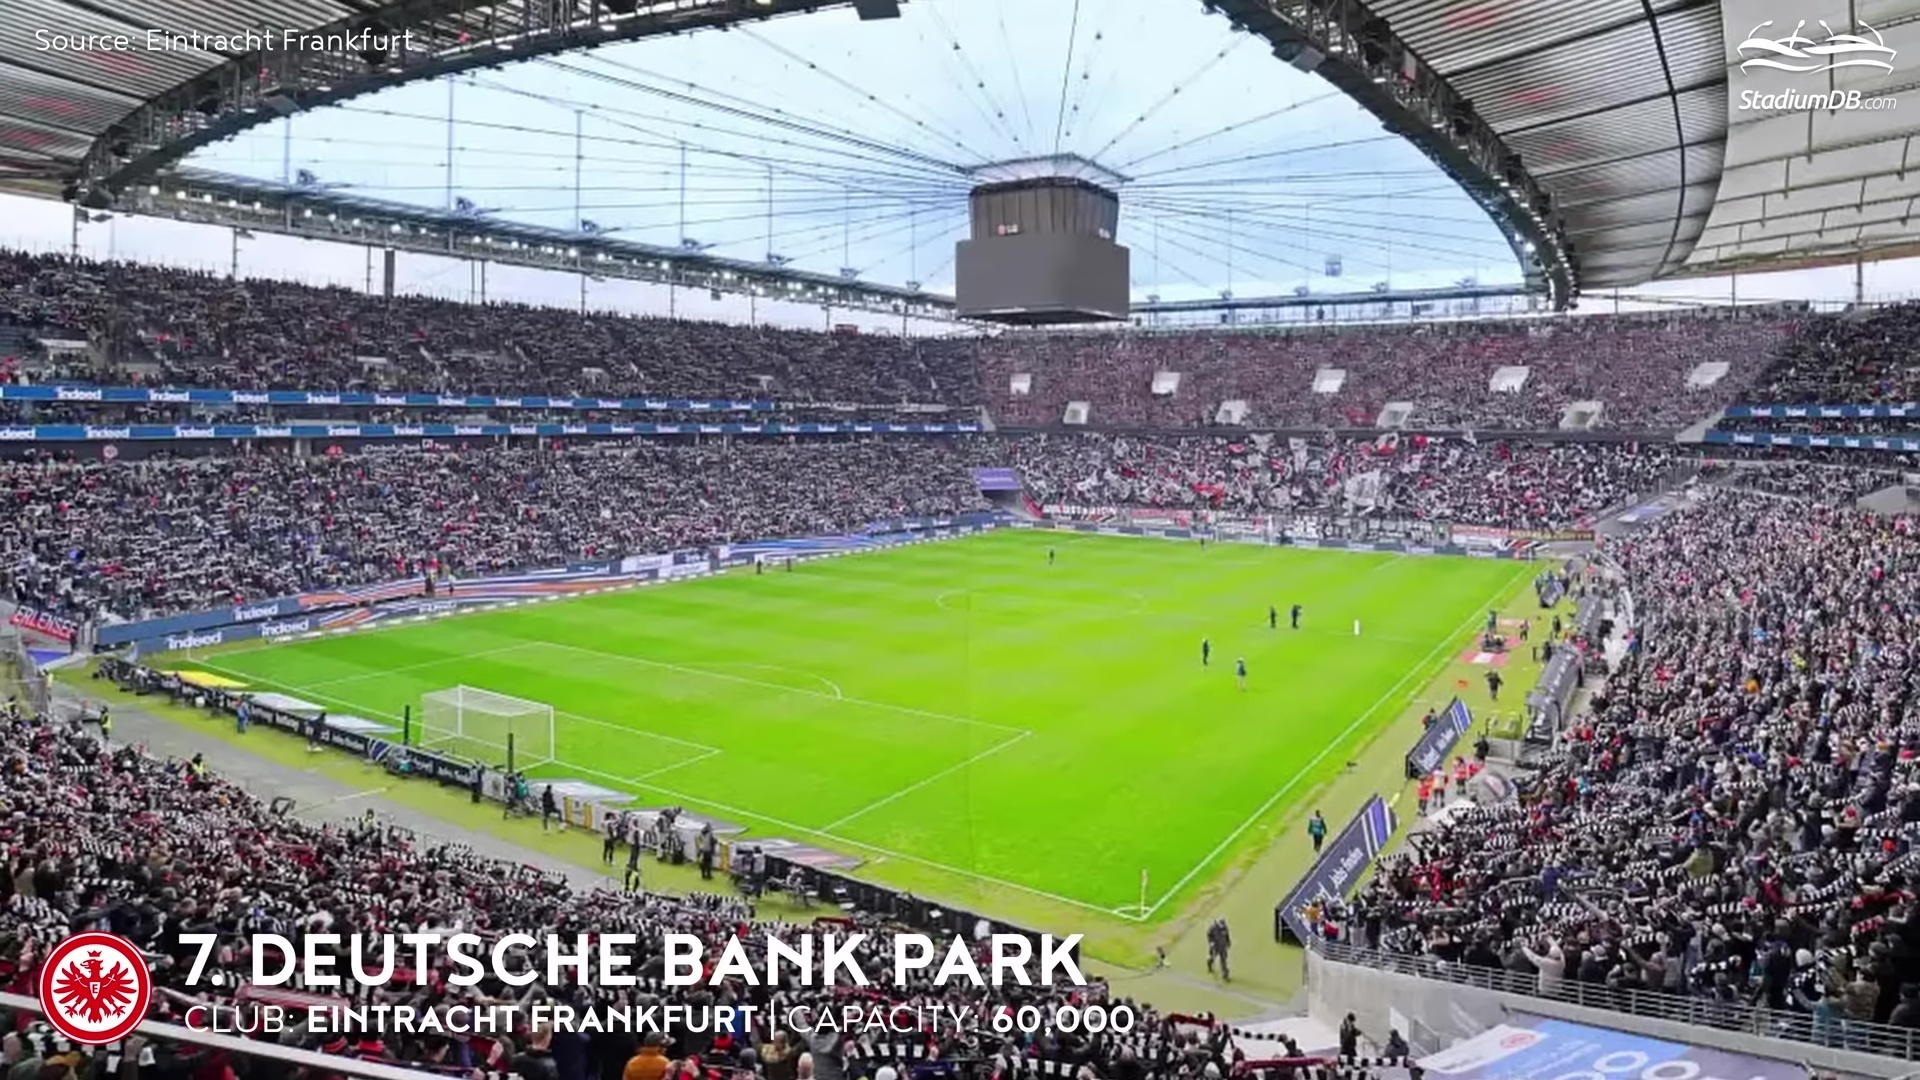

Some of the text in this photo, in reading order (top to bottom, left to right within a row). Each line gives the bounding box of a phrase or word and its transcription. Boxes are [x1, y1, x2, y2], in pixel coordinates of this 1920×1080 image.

[57, 387, 102, 400] indeed
[235, 604, 279, 621] indeed
[166, 619, 310, 650] indeed indeed
